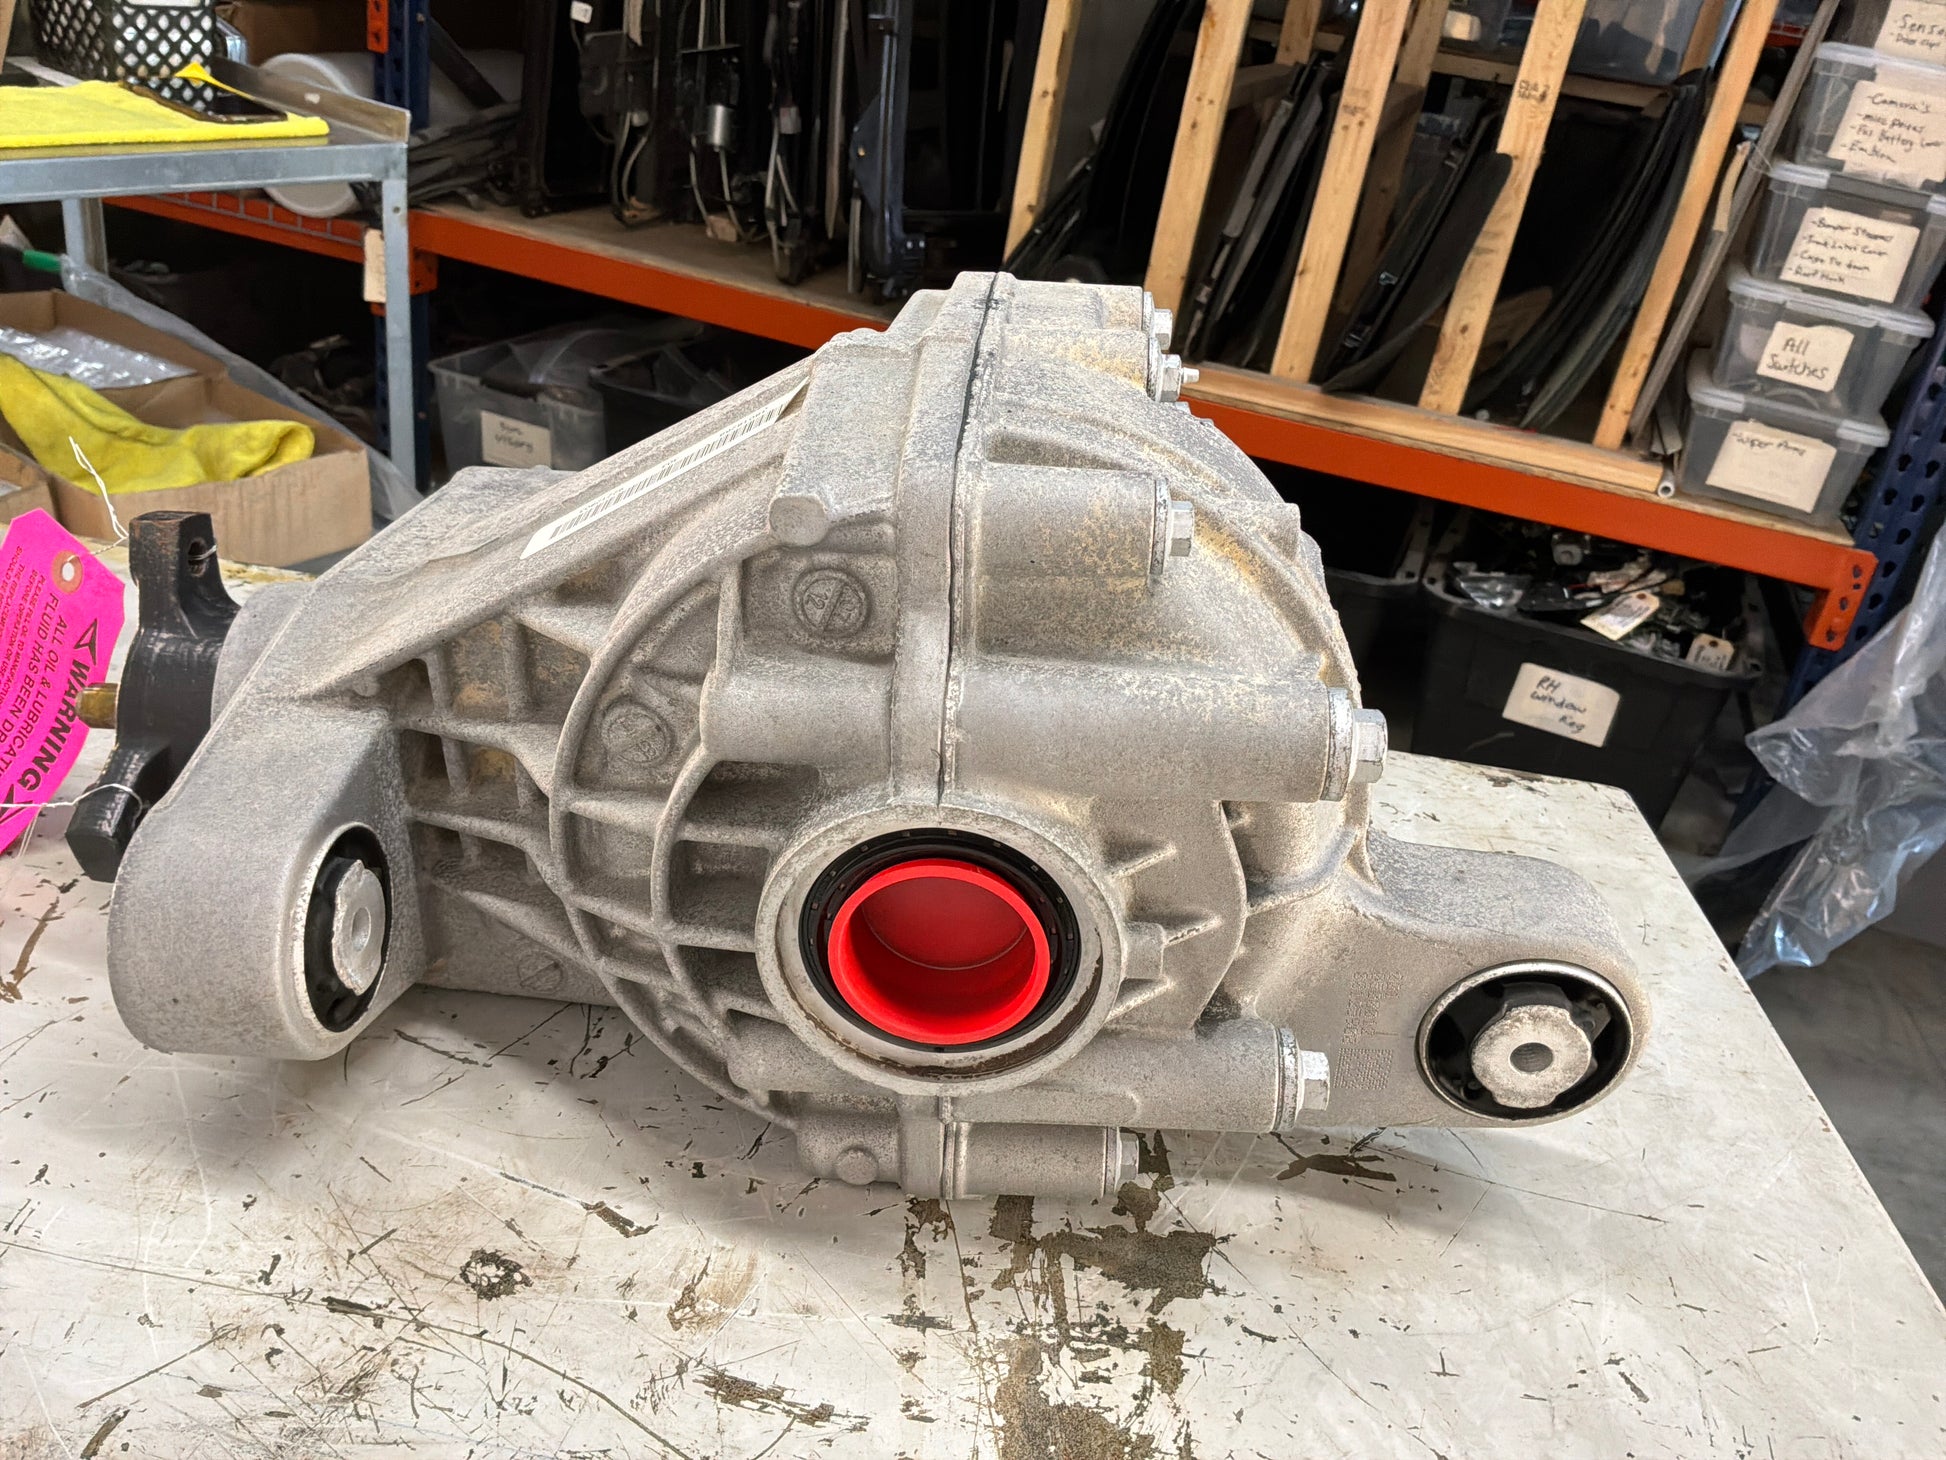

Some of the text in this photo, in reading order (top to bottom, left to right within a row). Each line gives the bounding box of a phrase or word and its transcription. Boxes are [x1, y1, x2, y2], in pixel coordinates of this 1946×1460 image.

[1899, 13, 1946, 36] Senso
[1783, 337, 1811, 356] All
[4, 546, 23, 580] SHOULD
[0, 564, 24, 637] THE REPLACEME
[20, 569, 38, 606] BEFORE
[30, 575, 46, 608] PLEASE
[8, 603, 25, 647] OPERATION
[24, 607, 33, 623] FILL
[36, 593, 59, 638] FLUID
[51, 615, 67, 646] ALL
[17, 640, 25, 651] TO
[20, 625, 28, 637] OIL
[4, 648, 13, 661] OR
[27, 640, 44, 673] HAS
[45, 650, 58, 671] OIL
[9, 674, 35, 719] BEEN
[40, 677, 52, 689] &
[1536, 675, 1562, 694] RH
[16, 659, 91, 791] WARNING
